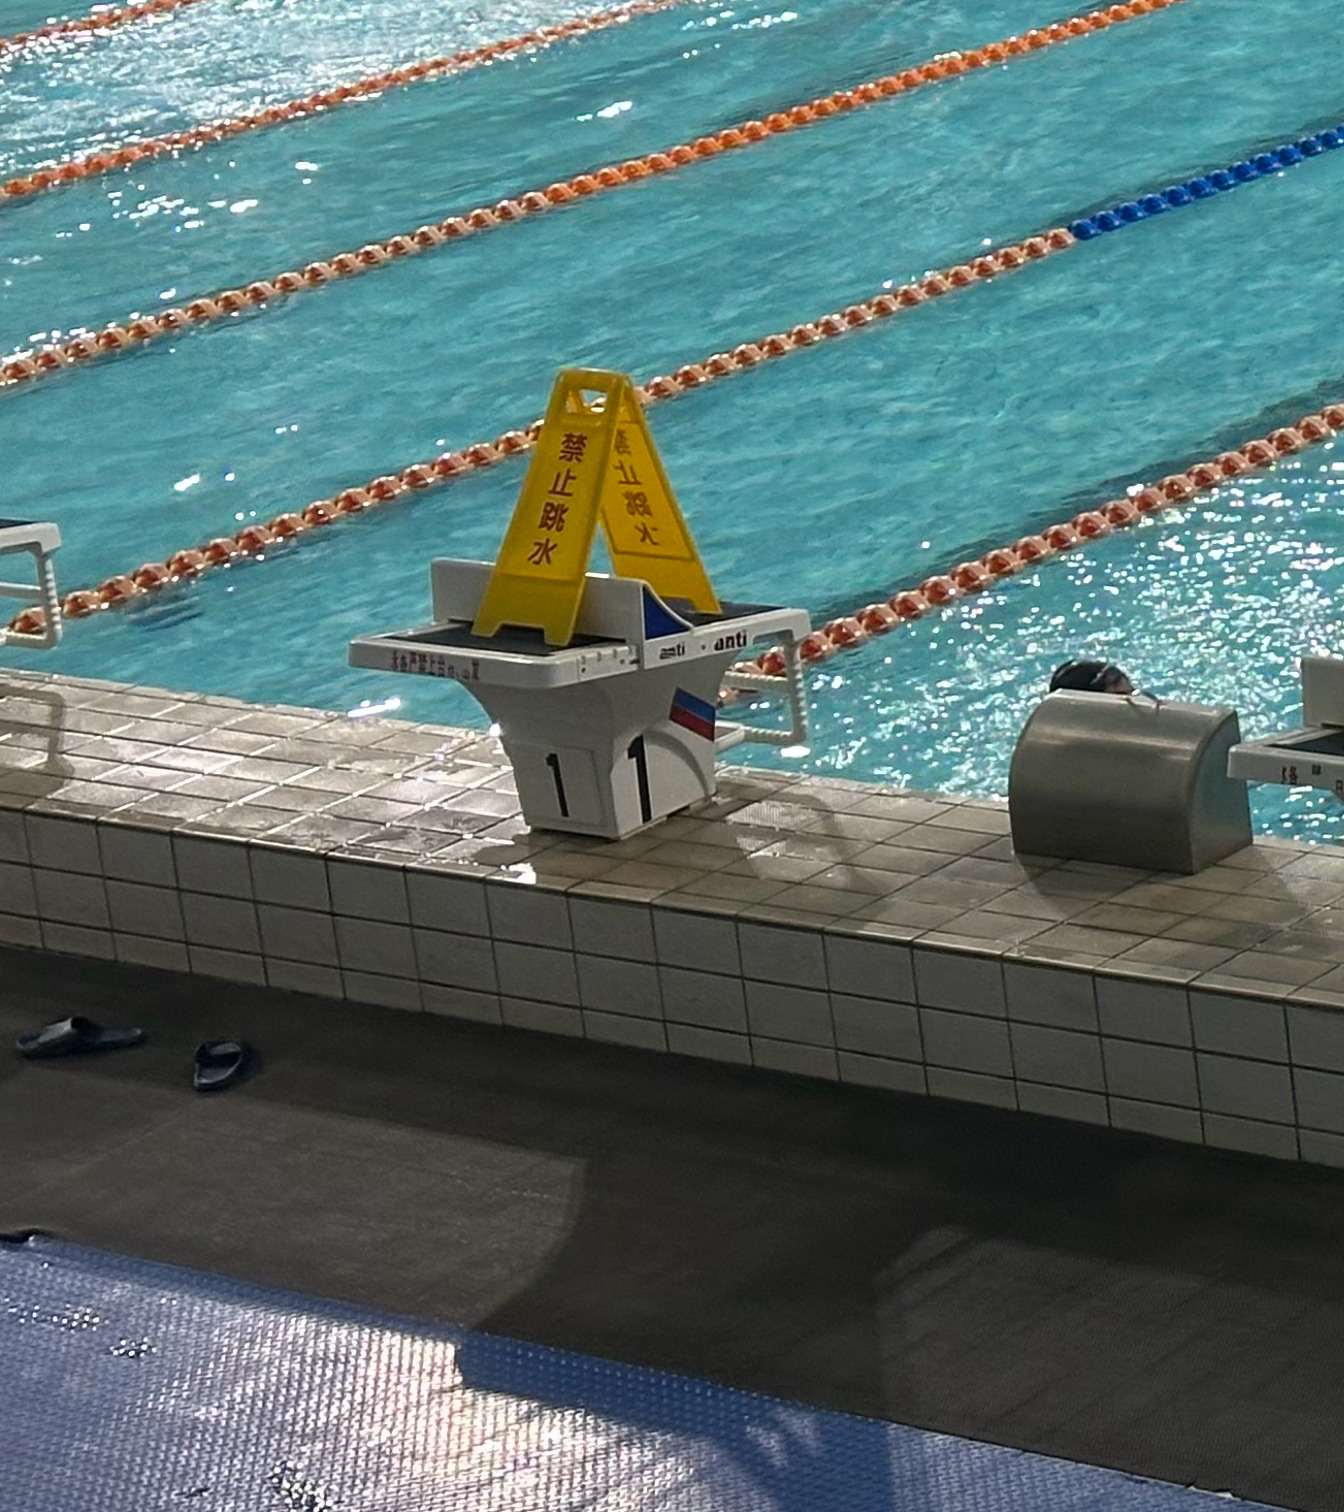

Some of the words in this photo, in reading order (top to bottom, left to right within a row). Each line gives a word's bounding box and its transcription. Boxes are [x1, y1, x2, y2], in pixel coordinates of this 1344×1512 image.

[526, 432, 588, 566] 禁止跳水
[714, 629, 748, 652] anti
[545, 753, 570, 817] 1
[627, 735, 652, 823] 1
